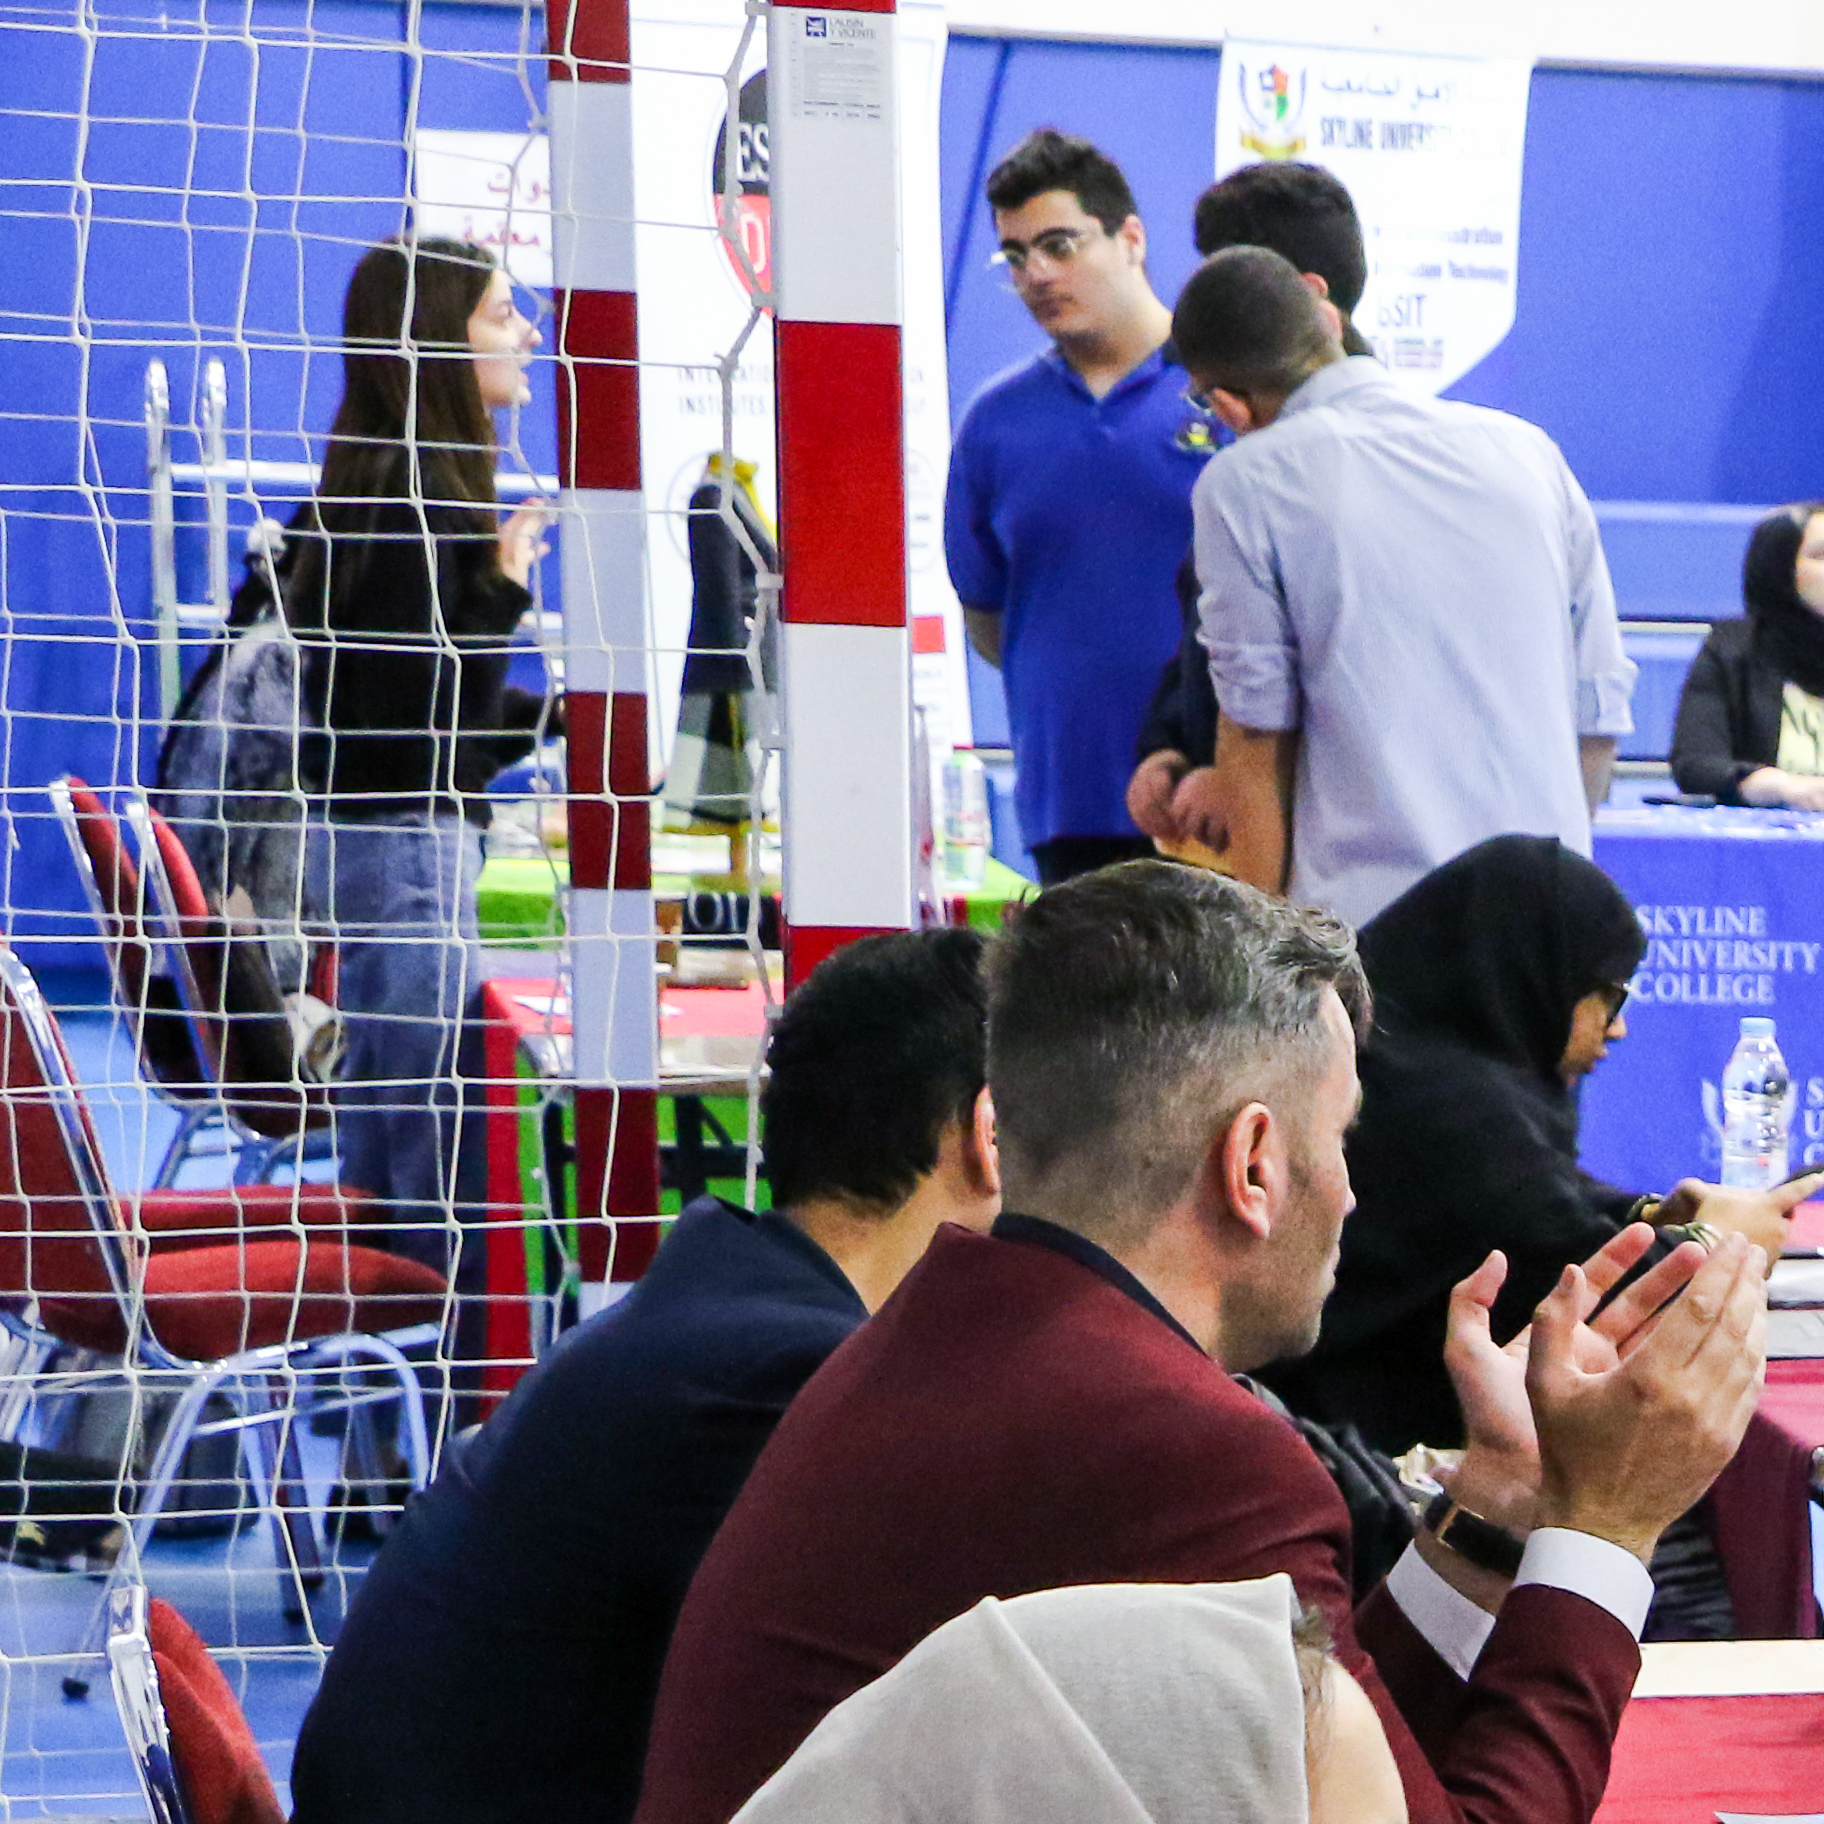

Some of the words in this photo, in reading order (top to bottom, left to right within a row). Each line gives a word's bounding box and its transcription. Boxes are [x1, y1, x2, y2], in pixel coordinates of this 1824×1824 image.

[1637, 907, 1766, 937] SKYLINE
[1640, 941, 1821, 974] UNIVERSITY
[1631, 972, 1775, 1005] COLLEGE
